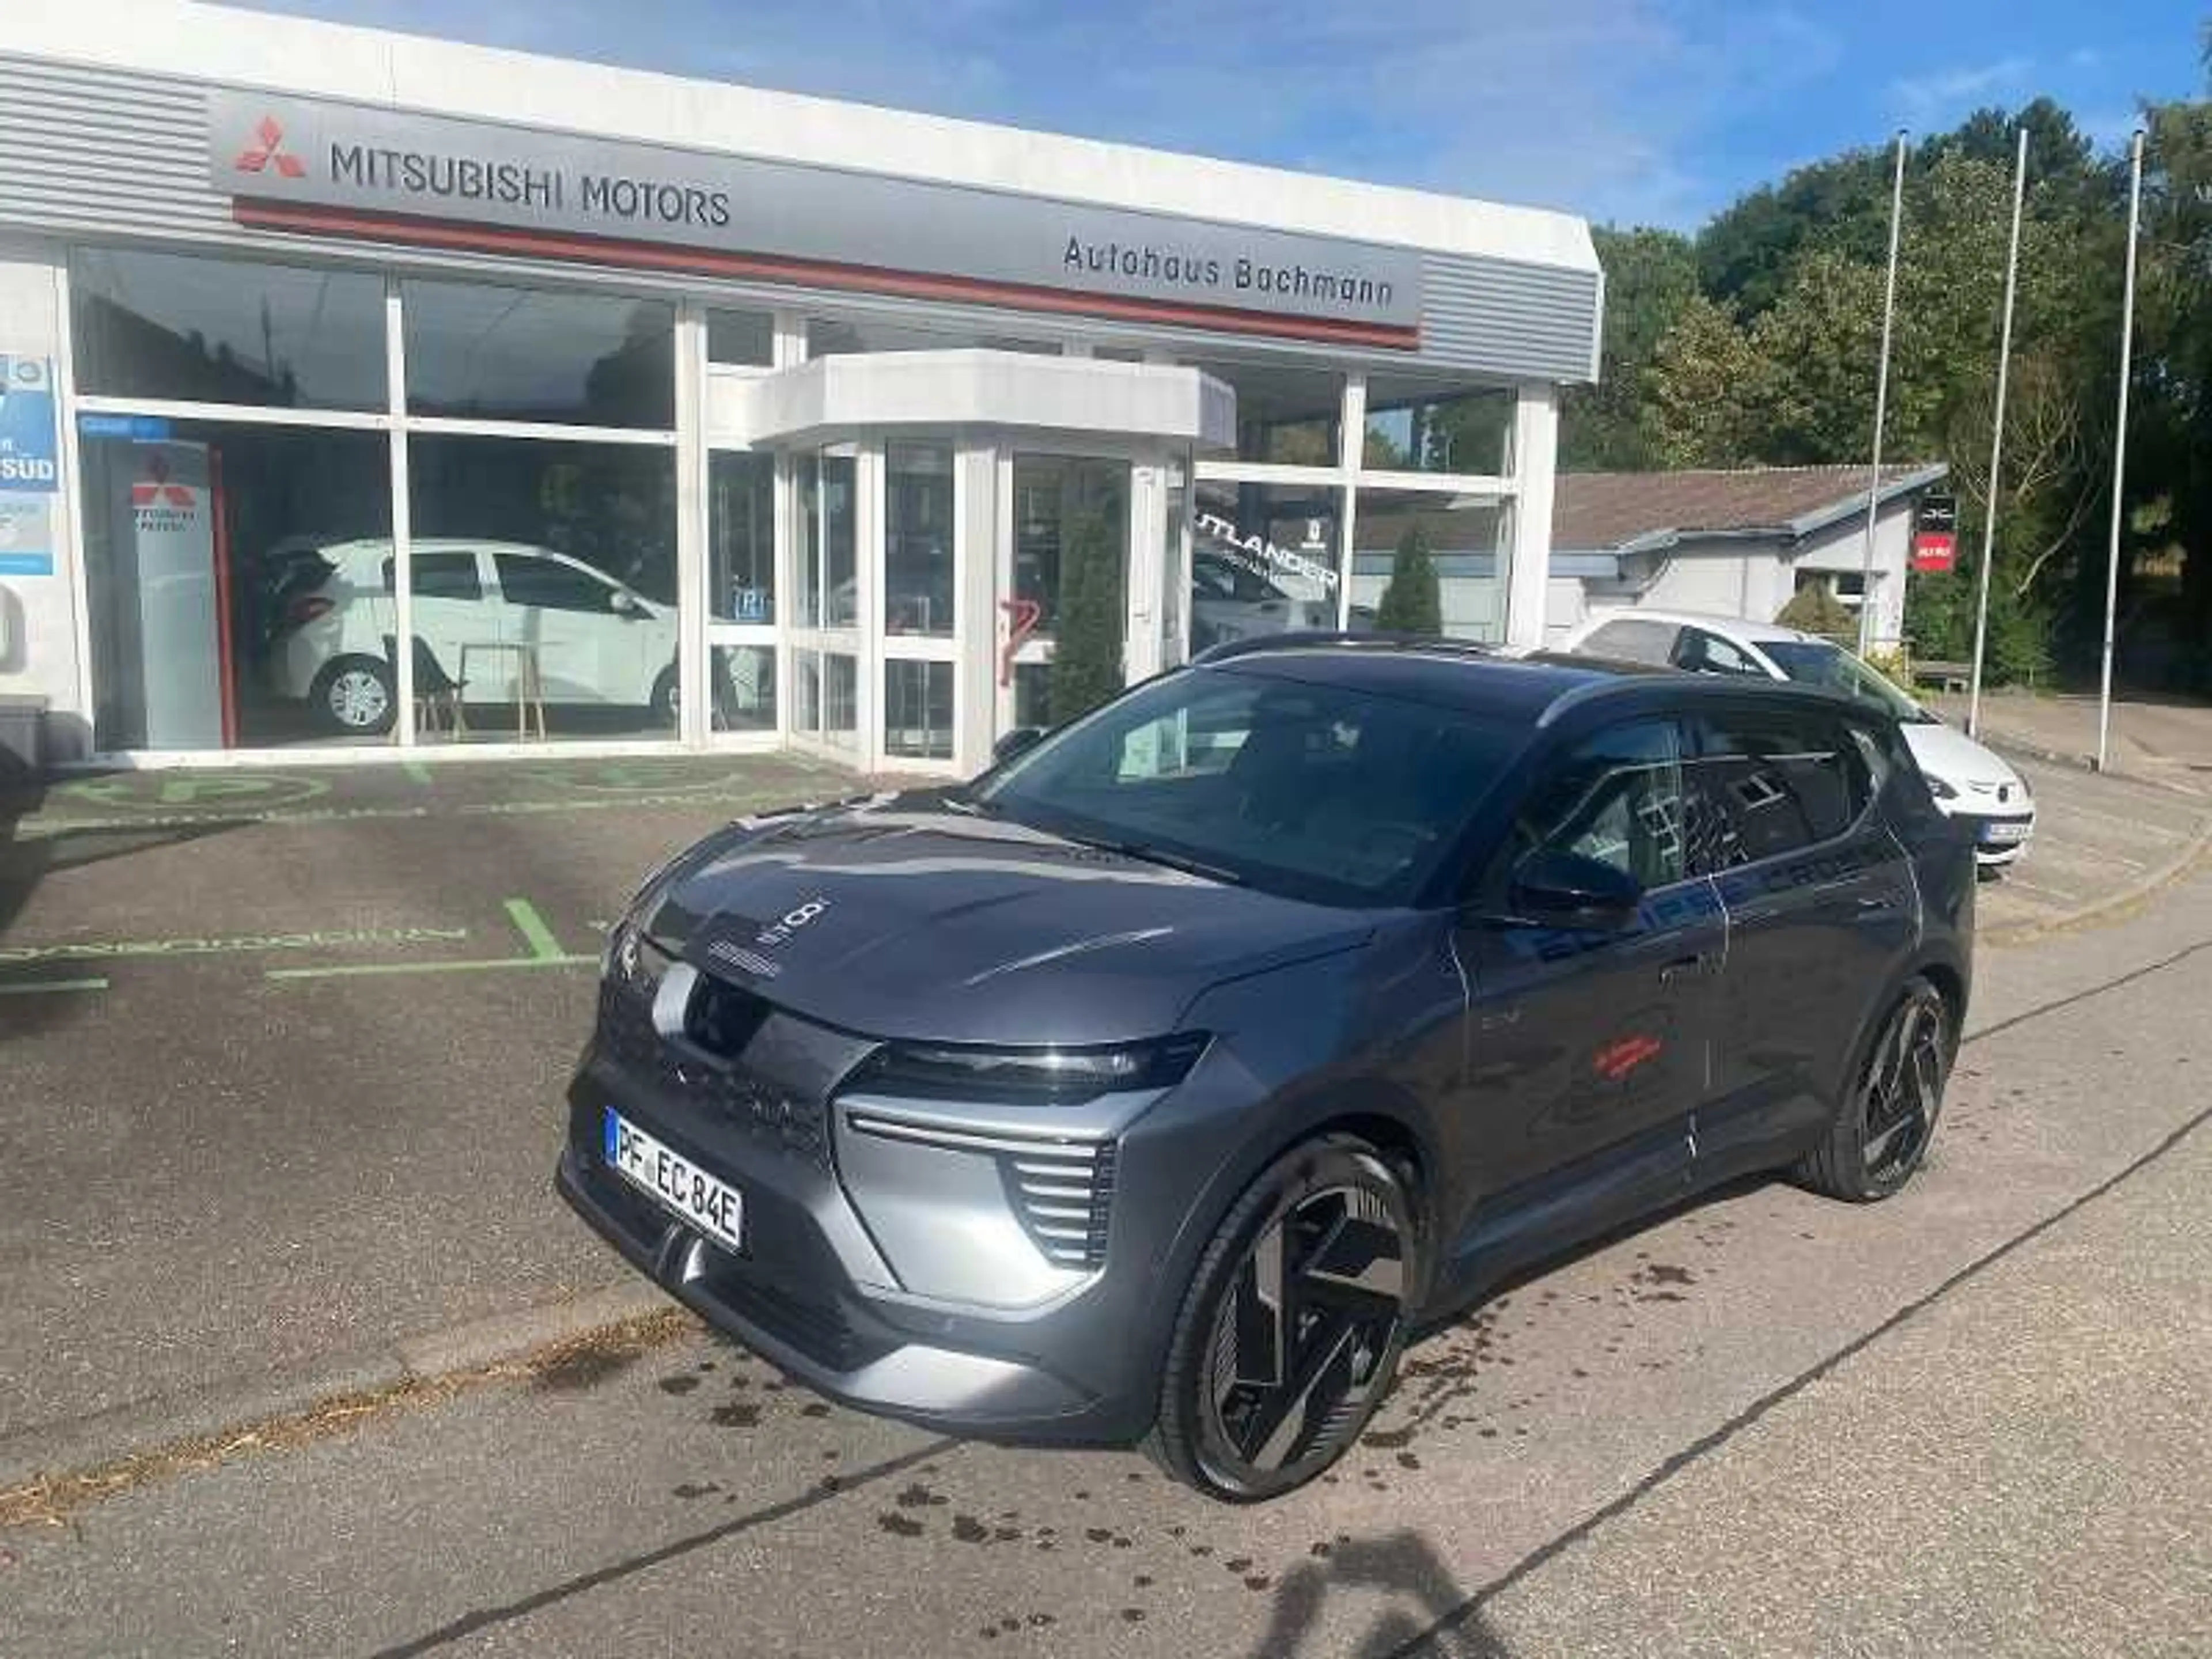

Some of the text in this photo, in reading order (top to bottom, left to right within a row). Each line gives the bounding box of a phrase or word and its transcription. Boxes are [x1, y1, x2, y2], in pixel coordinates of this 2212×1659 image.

[331, 143, 730, 226] MITSUBISHI MOTORS
[1063, 237, 1393, 307] Autohaus Bachmann
[1195, 513, 1338, 588] UTLANDER
[619, 1124, 645, 1169] PF
